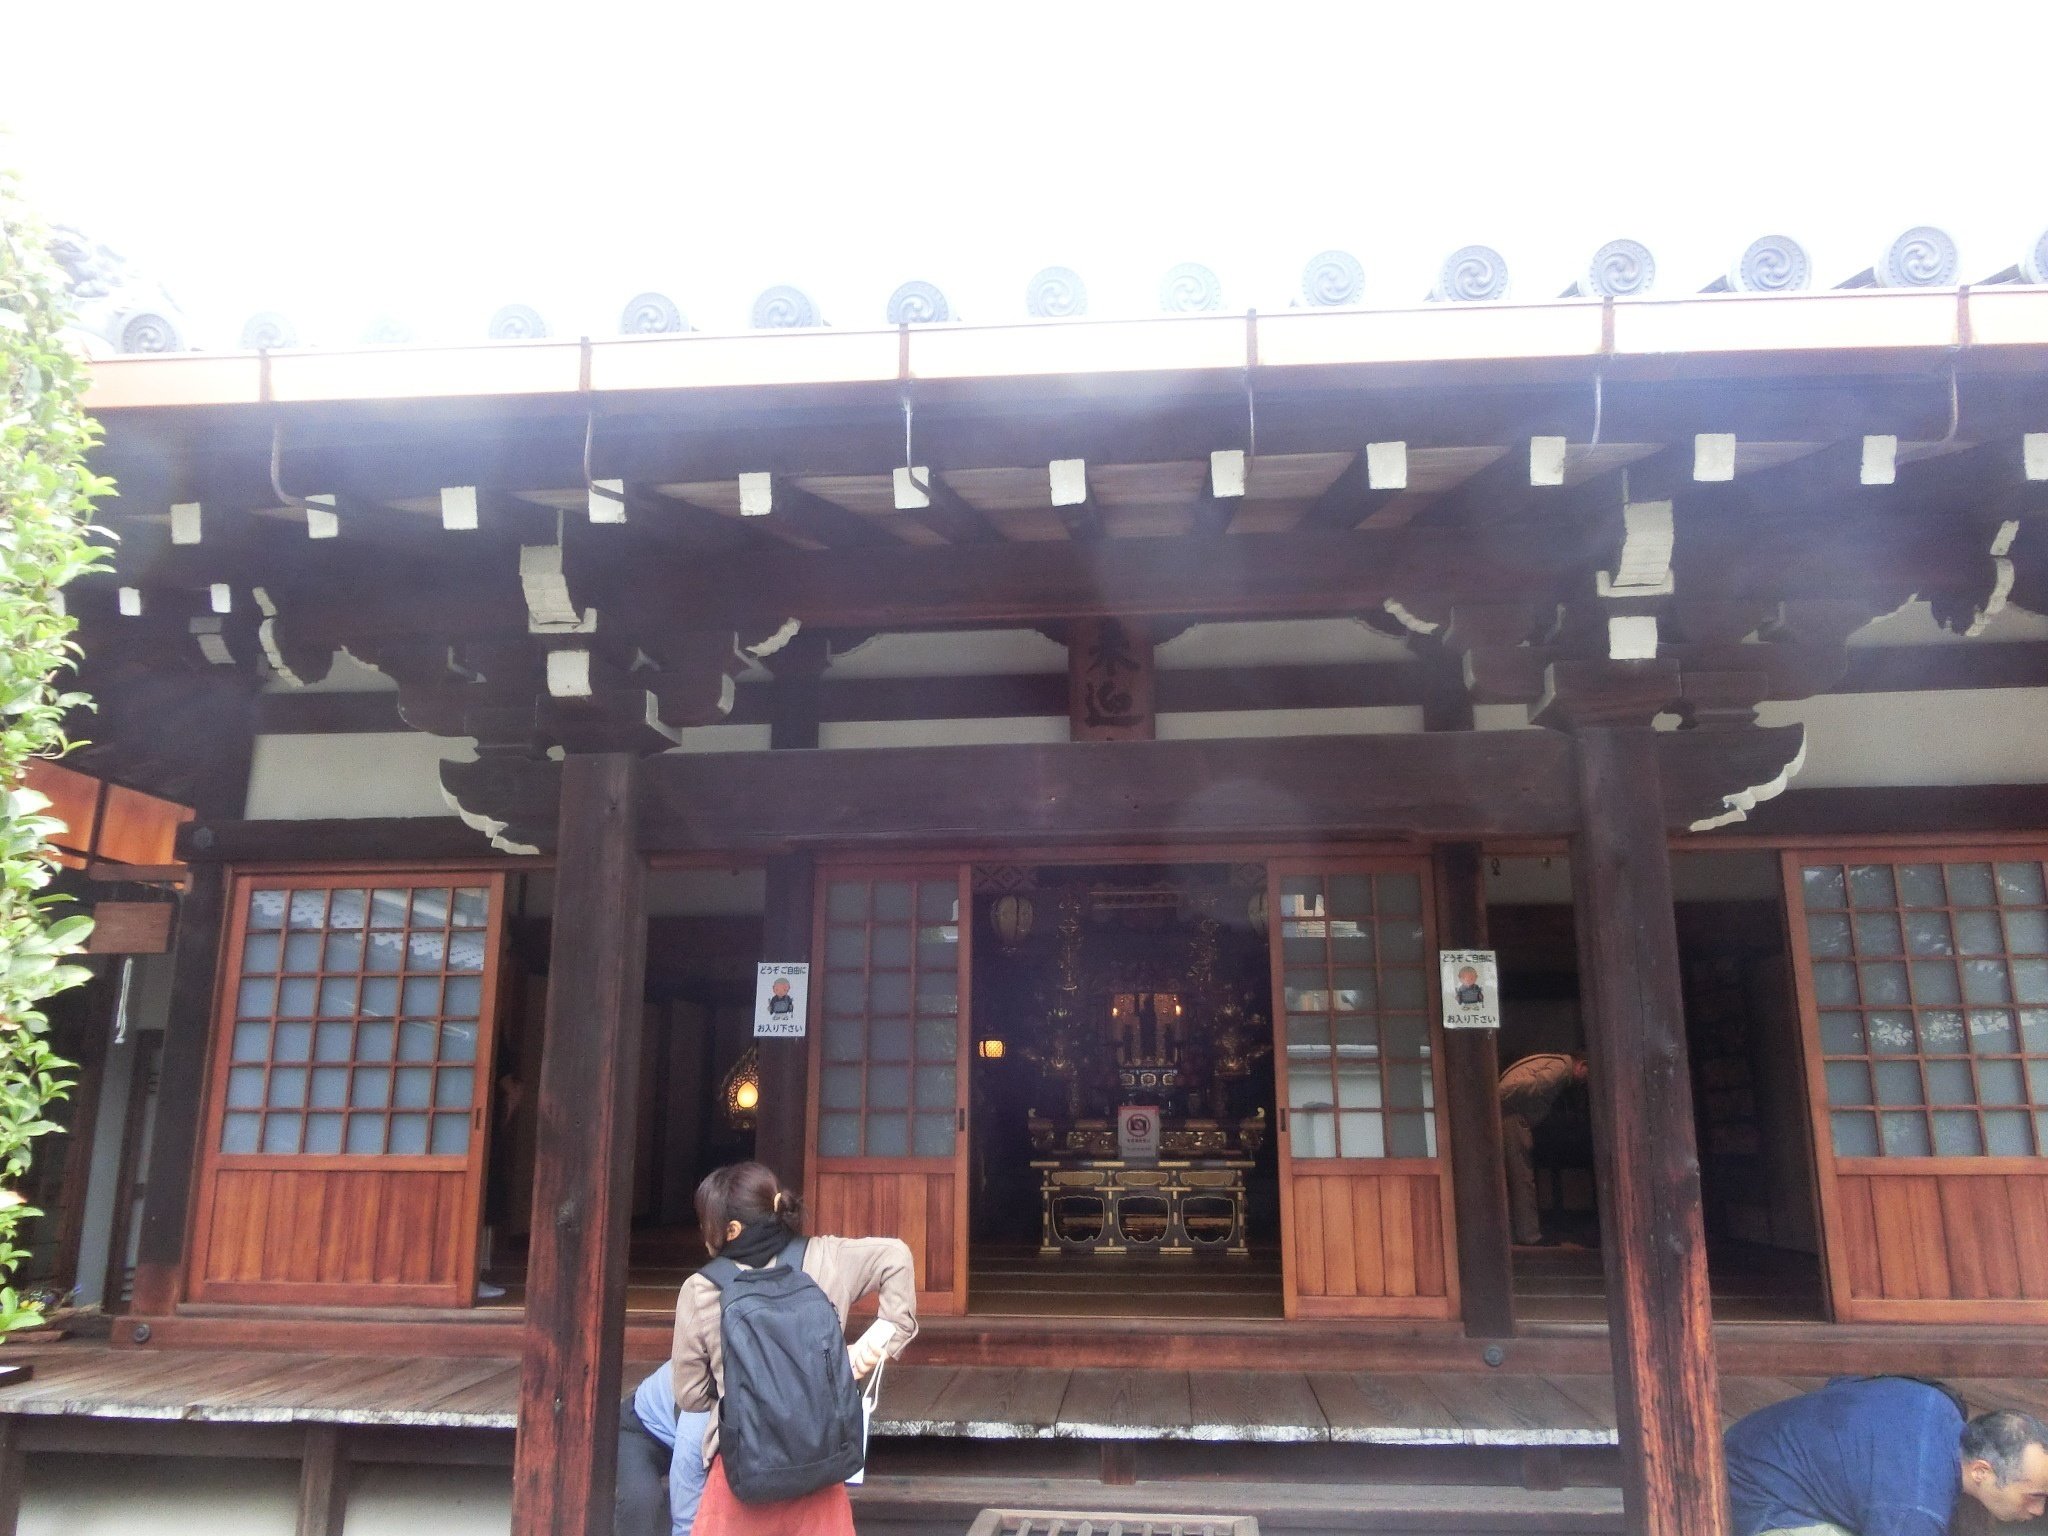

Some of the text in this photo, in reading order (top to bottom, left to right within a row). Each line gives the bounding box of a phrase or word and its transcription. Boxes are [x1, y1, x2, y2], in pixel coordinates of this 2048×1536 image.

[1447, 1014, 1496, 1024] お入り下さい
[757, 1024, 803, 1033] お入り下さい
